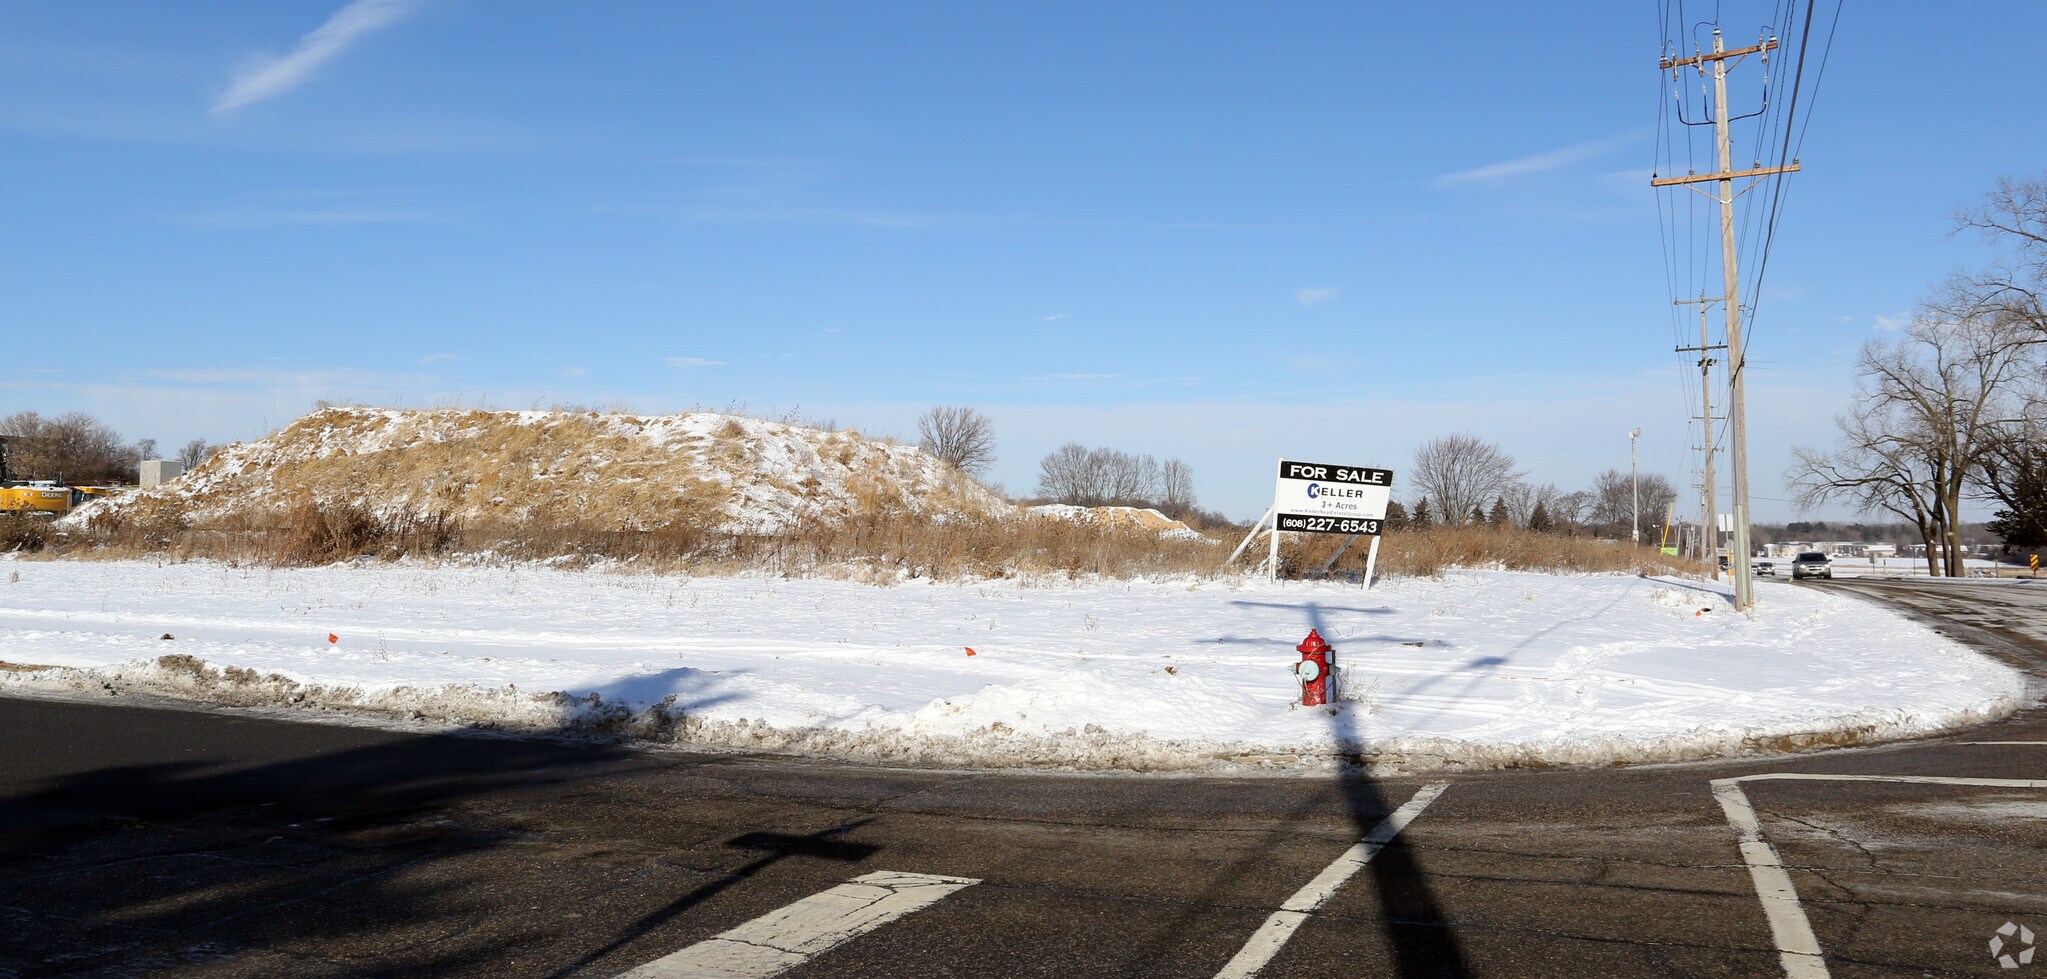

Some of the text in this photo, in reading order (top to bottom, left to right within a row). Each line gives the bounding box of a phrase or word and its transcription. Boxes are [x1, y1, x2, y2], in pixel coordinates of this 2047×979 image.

[1290, 465, 1384, 484] FOR SALE
[1308, 484, 1363, 498] KELLER
[1335, 502, 1358, 510] Acres
